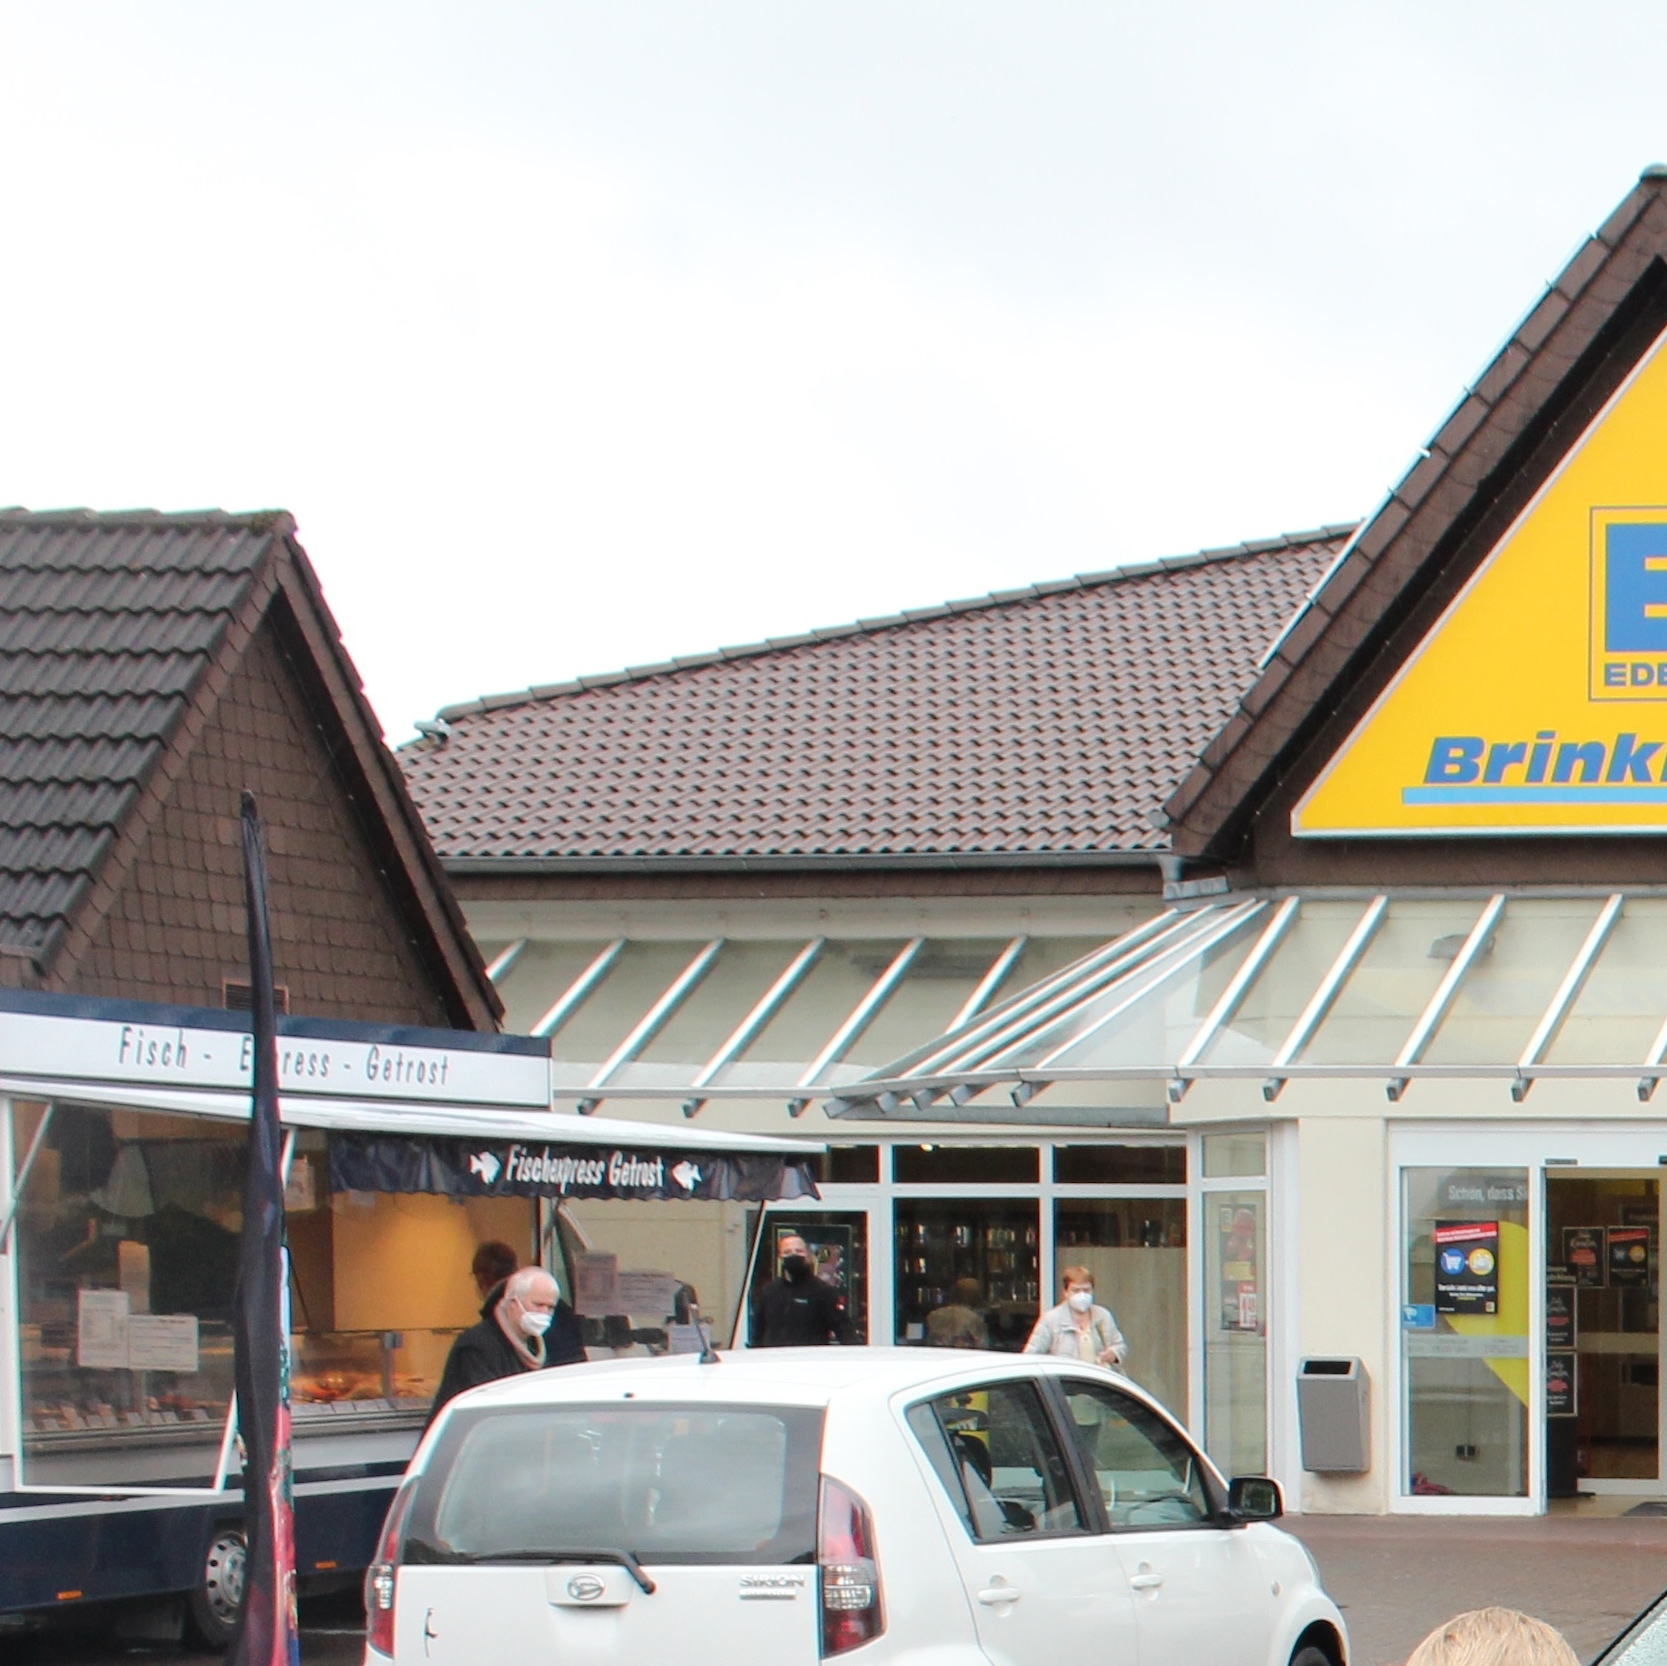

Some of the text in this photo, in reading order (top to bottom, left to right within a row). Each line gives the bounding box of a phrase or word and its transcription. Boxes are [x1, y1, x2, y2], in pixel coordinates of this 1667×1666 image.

[118, 1025, 449, 1086] Fisch Eress Getrost
[505, 1144, 664, 1194] Fischexpress Getrost
